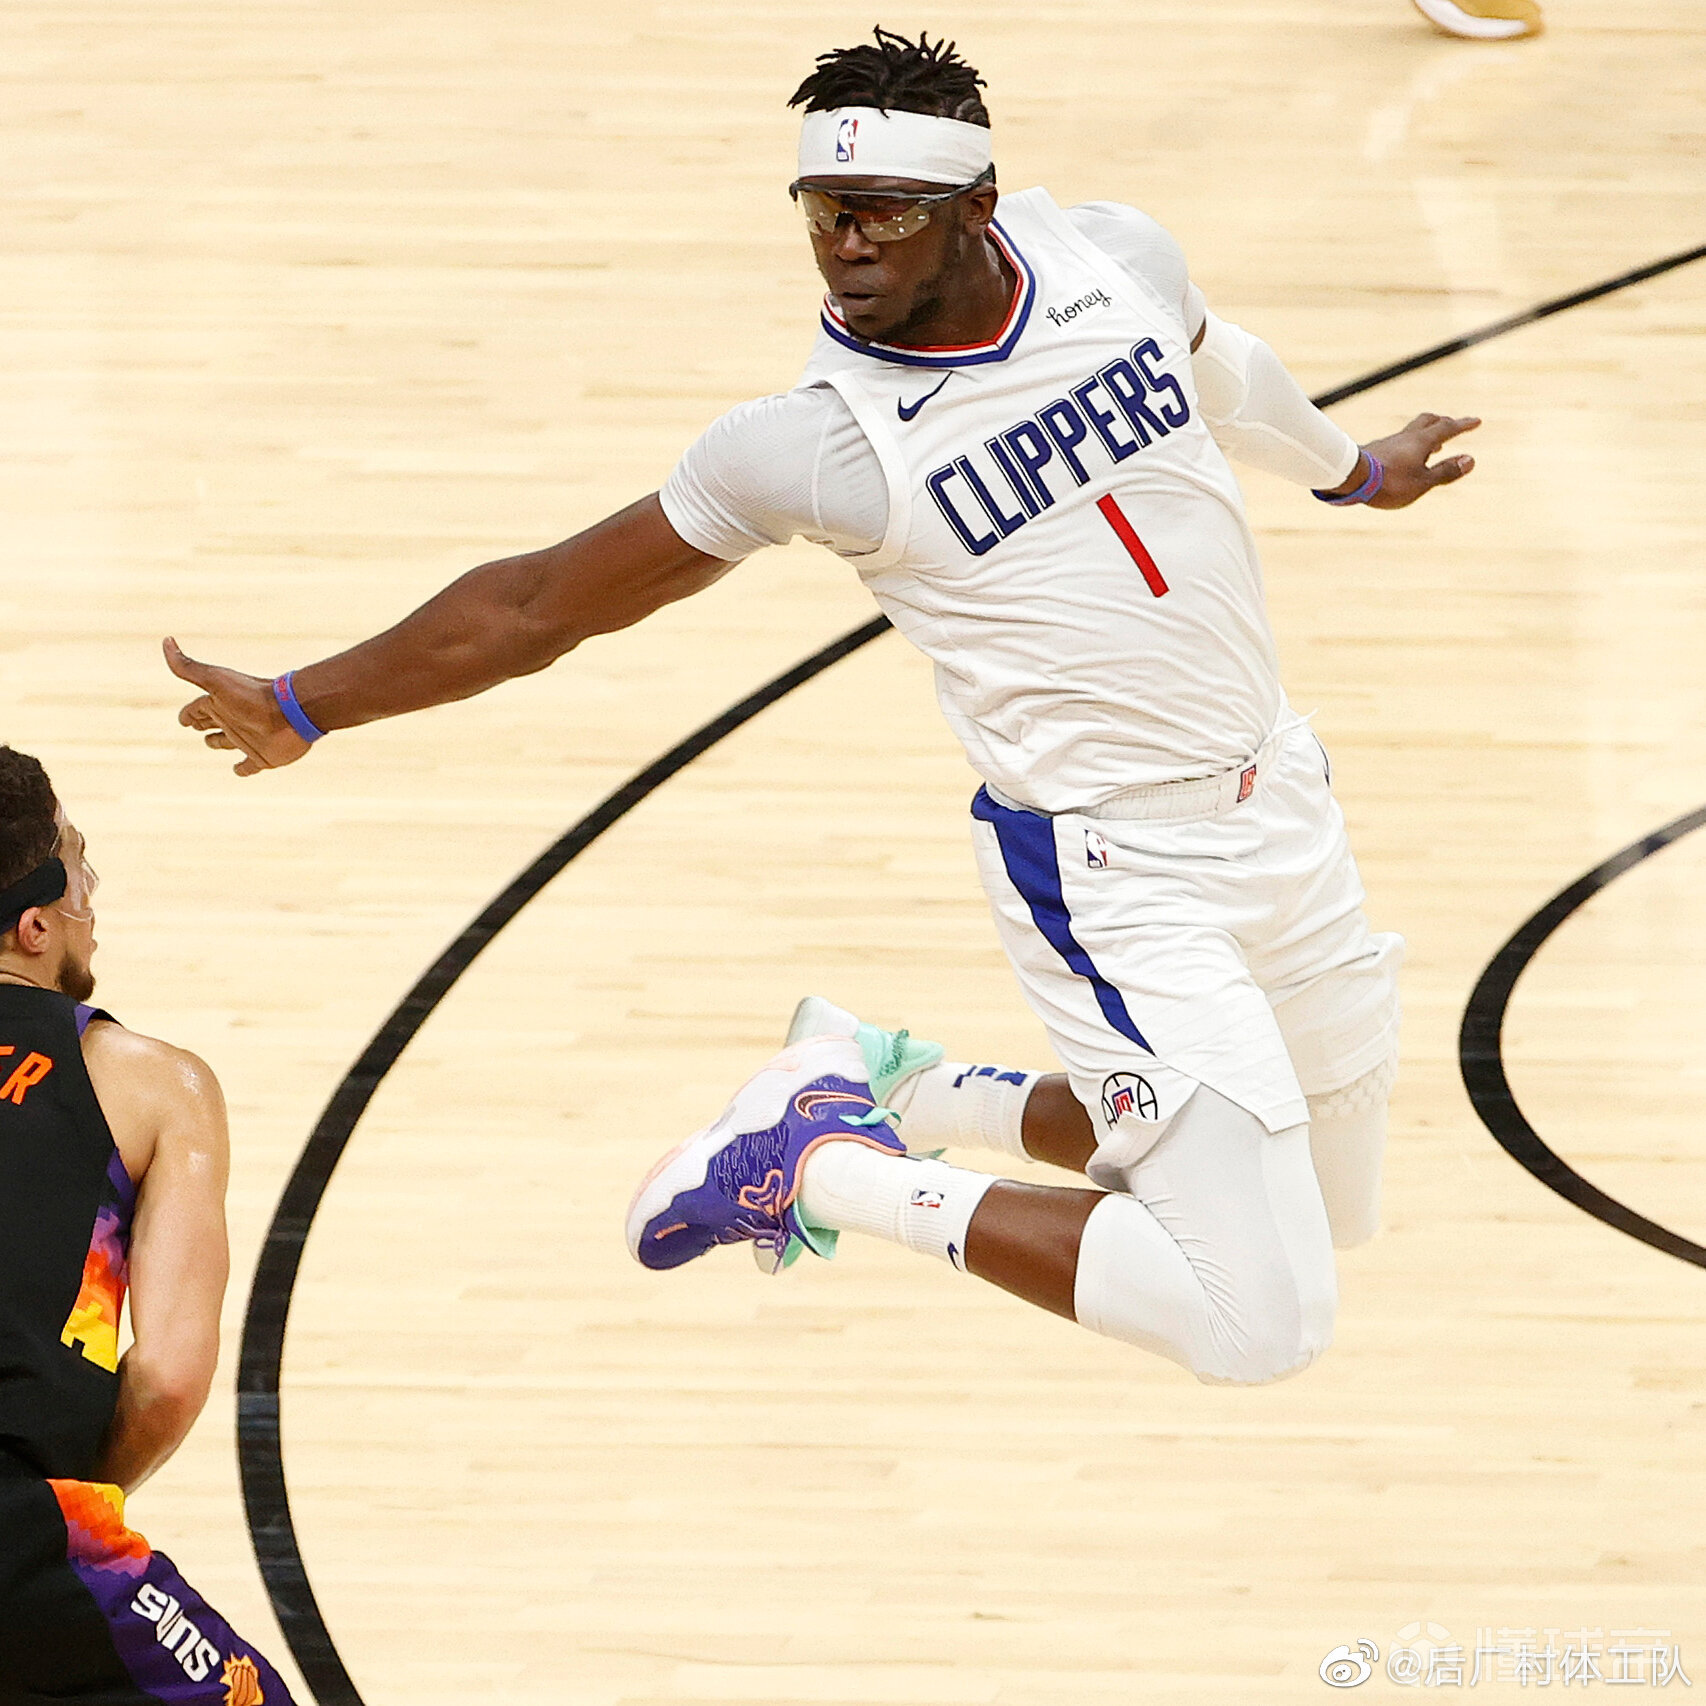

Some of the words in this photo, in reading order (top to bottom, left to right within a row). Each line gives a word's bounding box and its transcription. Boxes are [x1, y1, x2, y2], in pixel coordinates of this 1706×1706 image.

[1045, 288, 1112, 327] honey
[926, 337, 1190, 556] CLIPPERS
[1096, 492, 1169, 598] 1
[0, 1045, 54, 1106] R
